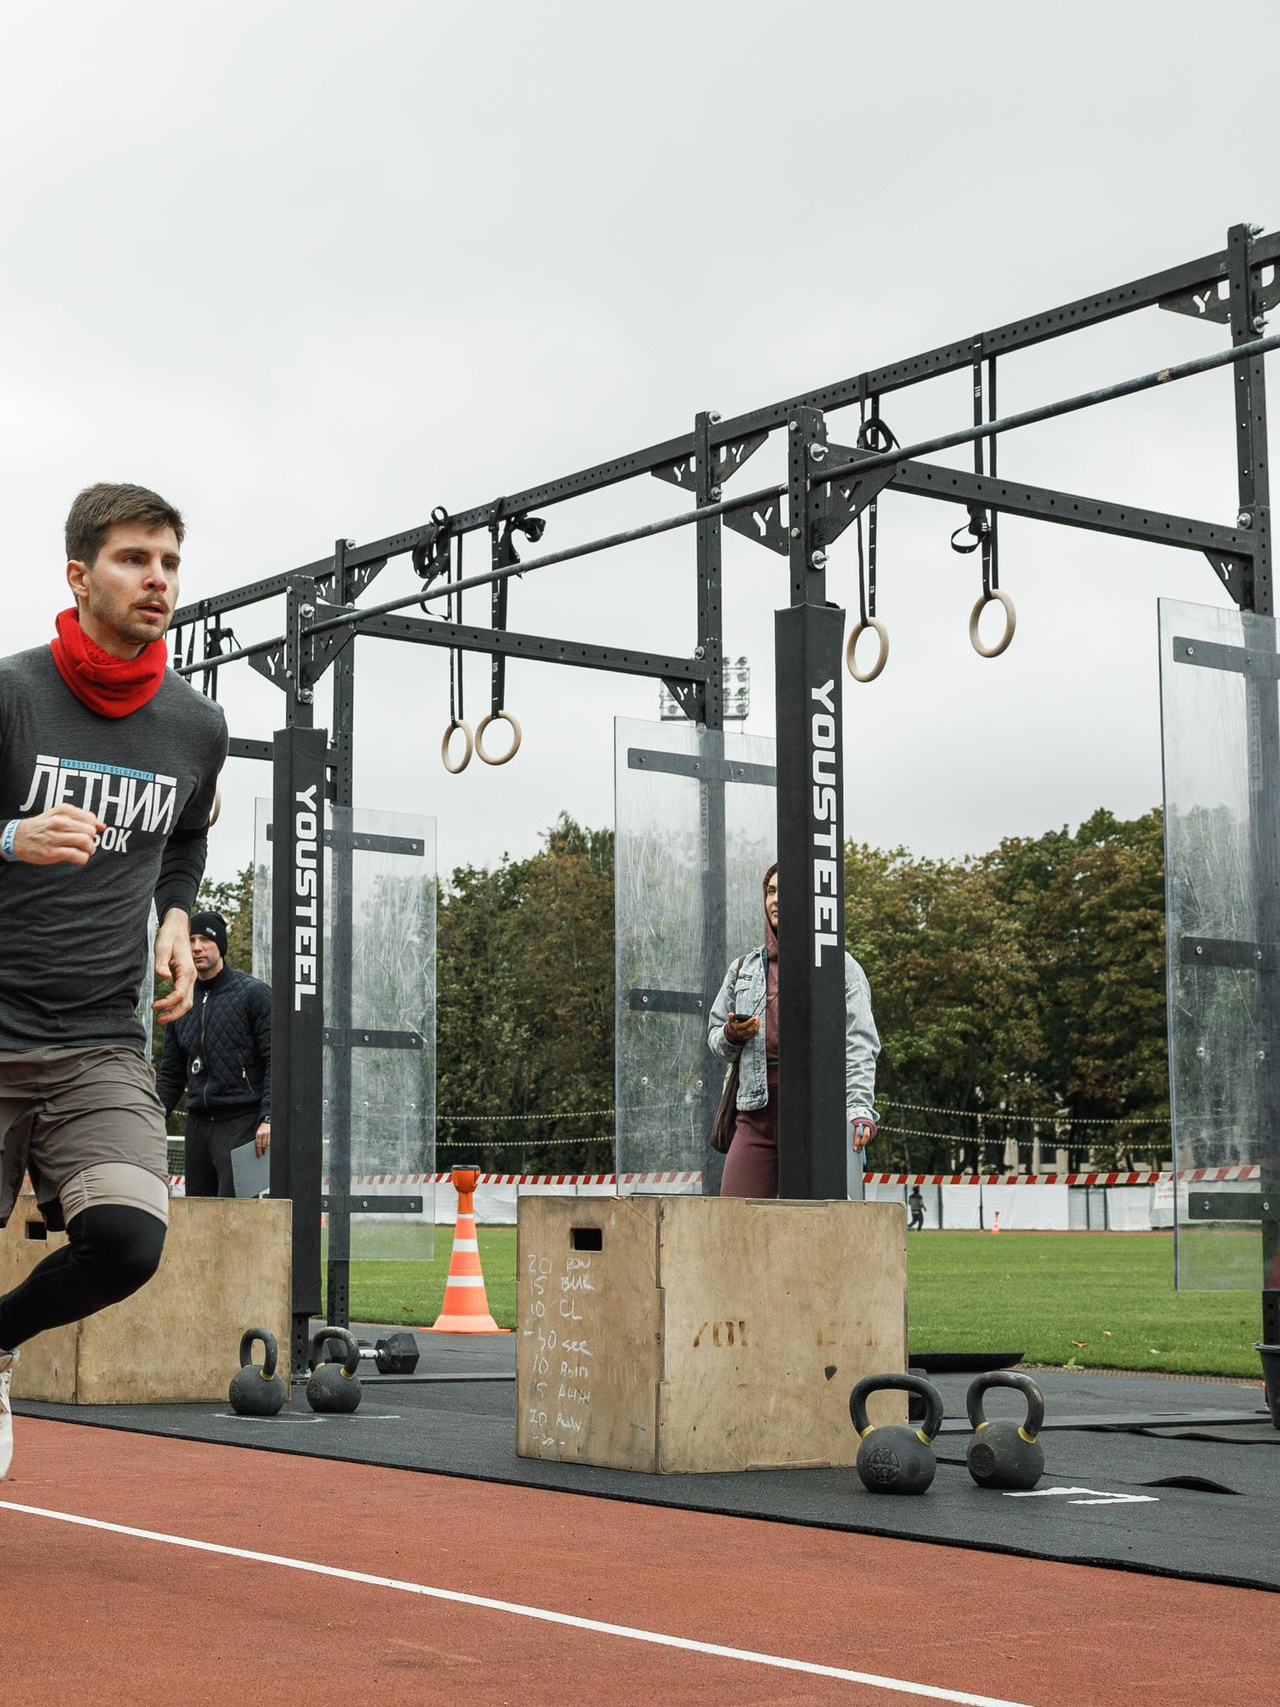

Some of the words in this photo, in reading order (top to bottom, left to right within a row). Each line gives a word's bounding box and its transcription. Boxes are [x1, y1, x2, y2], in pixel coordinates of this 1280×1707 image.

[294, 784, 318, 1012] YOUSTEEL
[811, 678, 839, 968] YOUSTEEL
[530, 1300, 546, 1319] 10
